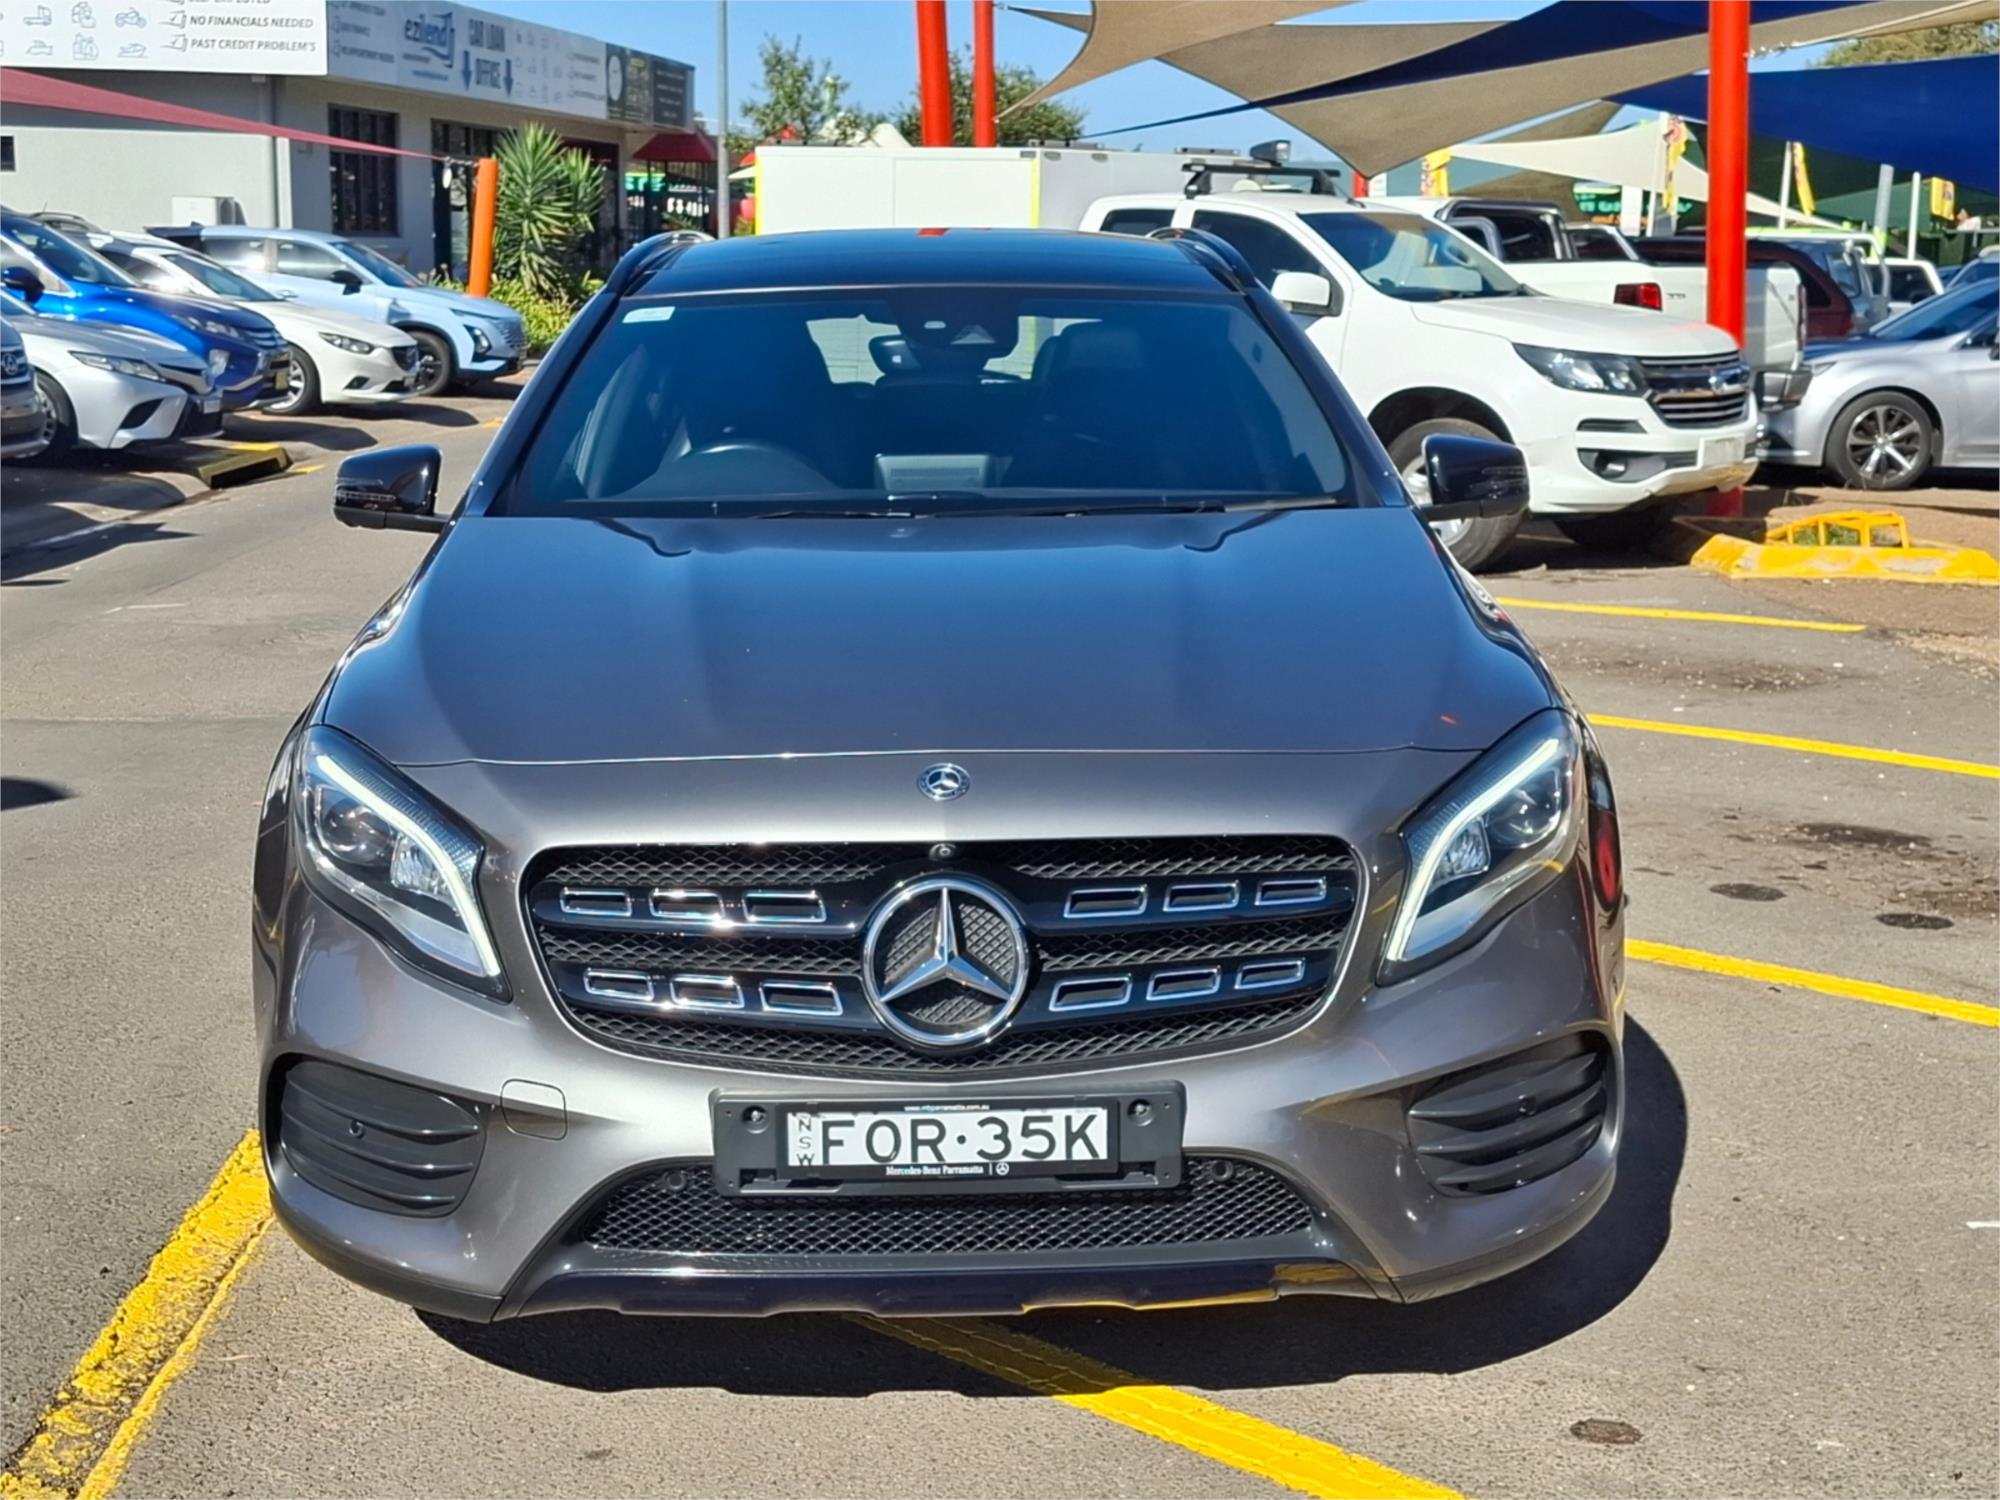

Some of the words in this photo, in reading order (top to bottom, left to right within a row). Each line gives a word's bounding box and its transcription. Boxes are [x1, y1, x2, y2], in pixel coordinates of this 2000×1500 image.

[189, 16, 206, 26] NO
[207, 16, 269, 27] FINANCIALS
[270, 18, 314, 28] NEEDED
[190, 39, 216, 49] PAST
[218, 39, 255, 50] CREDIT
[257, 40, 317, 52] PROBLEM'S
[885, 1165, 941, 1176] Mercedes-Benz
[942, 1165, 984, 1175] Parramatta
